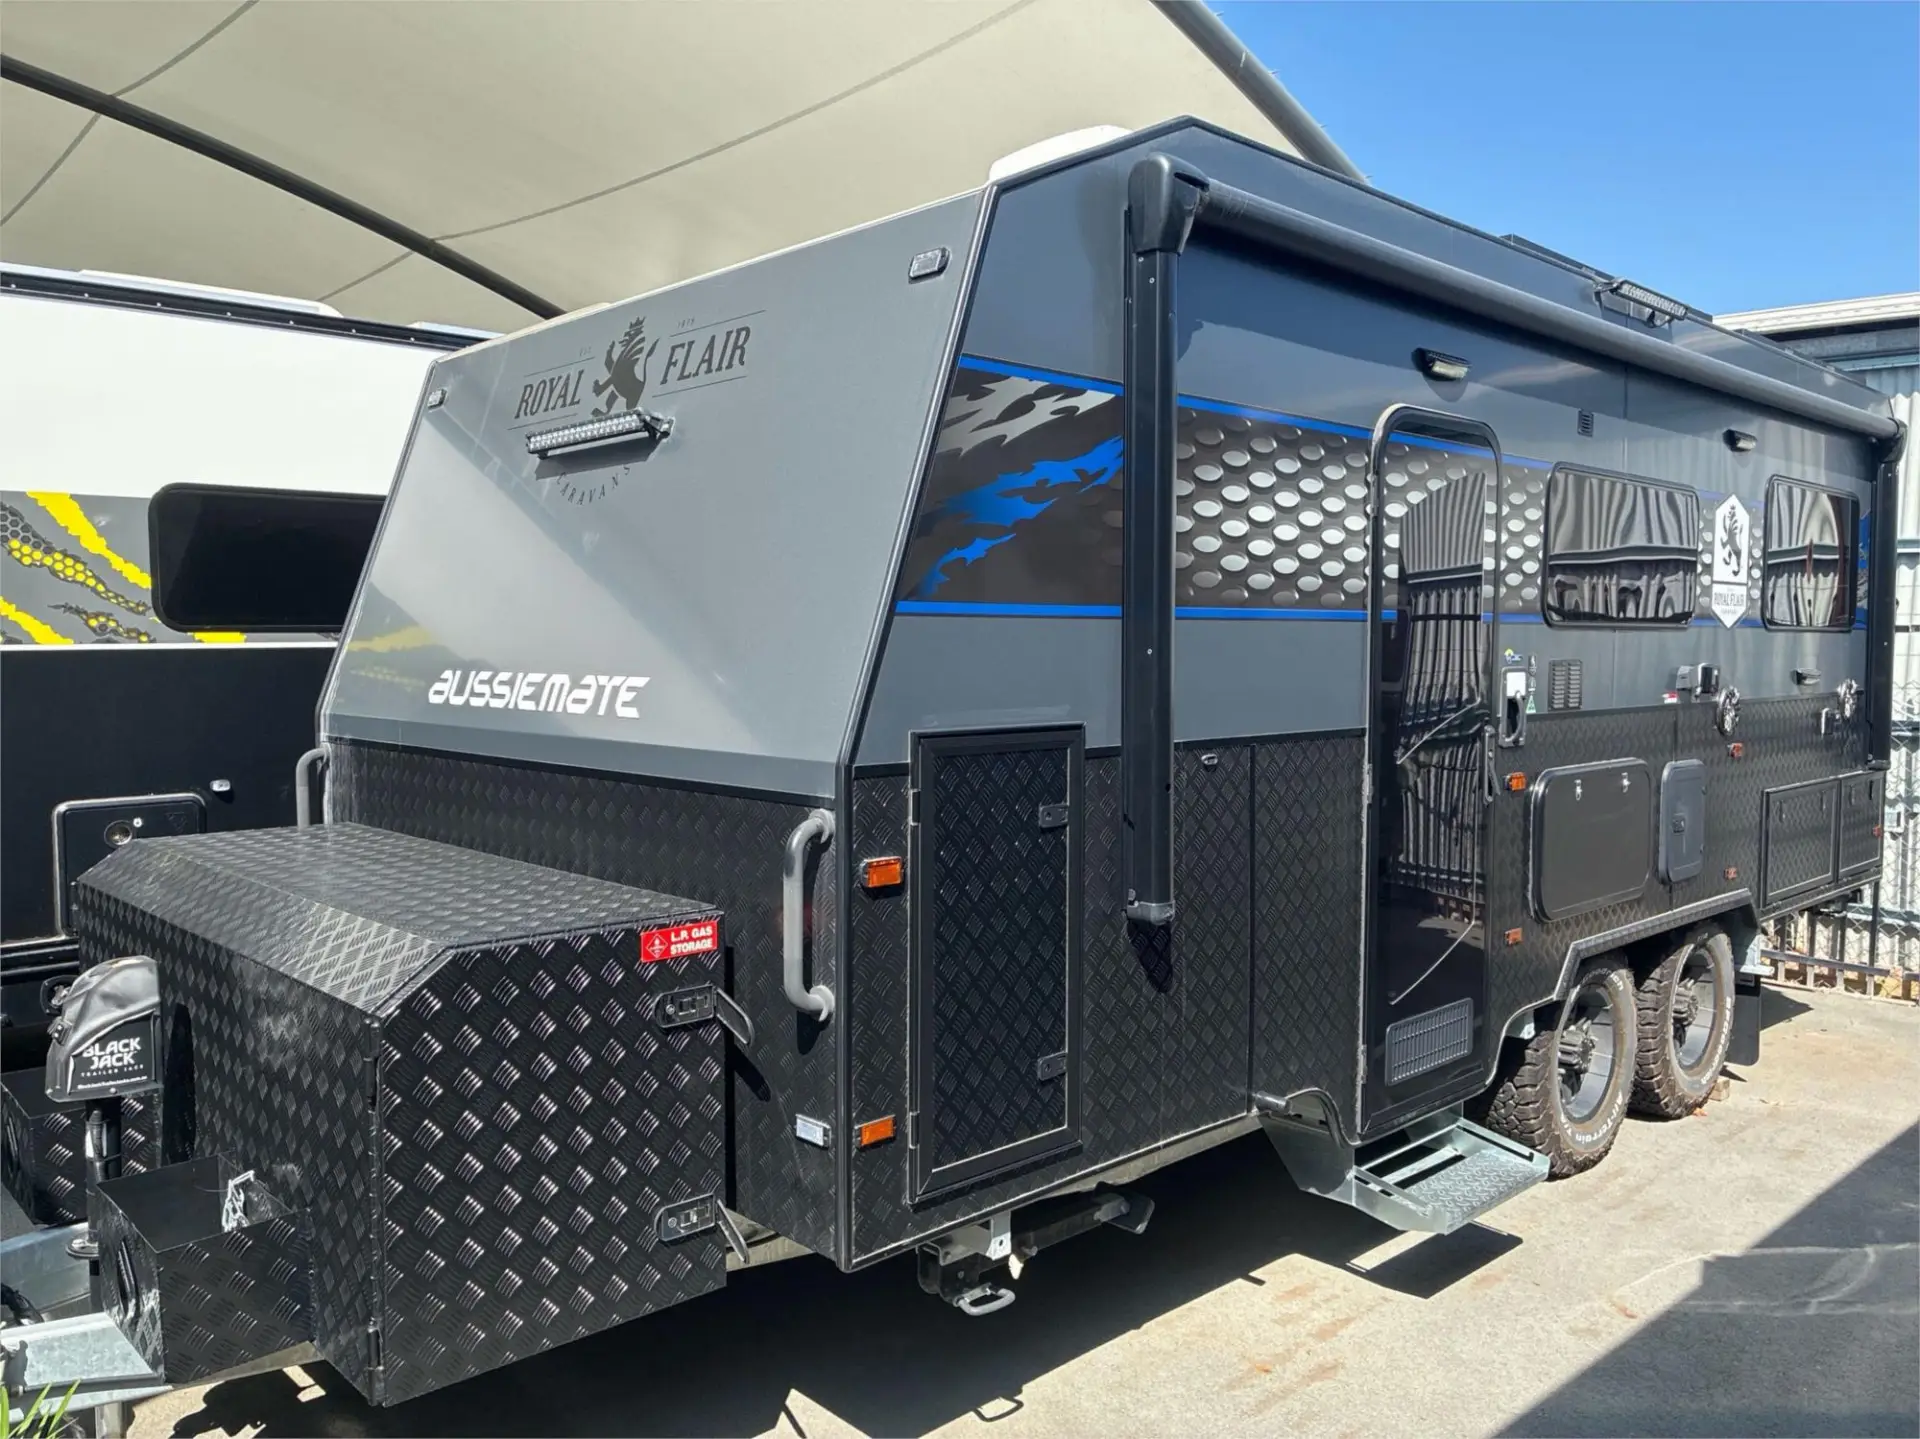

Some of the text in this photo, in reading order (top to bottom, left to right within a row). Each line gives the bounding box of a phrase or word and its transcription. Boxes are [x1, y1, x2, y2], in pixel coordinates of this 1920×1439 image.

[514, 326, 751, 420] ROYAL FLAIR
[556, 464, 631, 506] CARAVANS
[691, 926, 713, 938] GAS
[670, 938, 713, 955] STORAGE
[82, 1037, 141, 1057] BLACK
[90, 1051, 135, 1069] JACK
